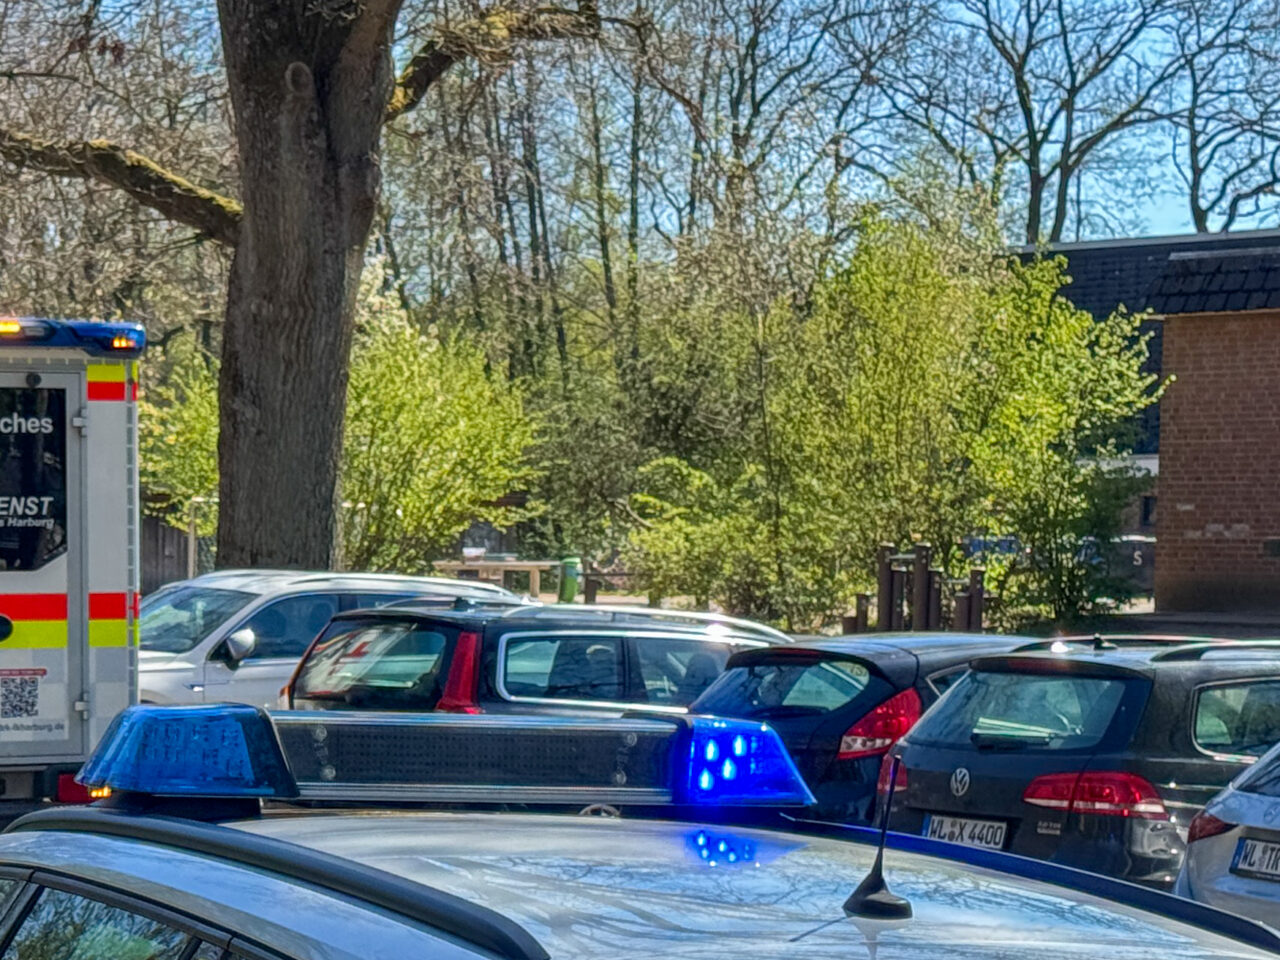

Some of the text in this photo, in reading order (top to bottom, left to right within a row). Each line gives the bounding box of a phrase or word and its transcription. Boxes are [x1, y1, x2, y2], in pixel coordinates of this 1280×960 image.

[7, 517, 55, 529] Harburg
[930, 817, 1004, 846] WL X 4400
[1241, 842, 1257, 867] WL
